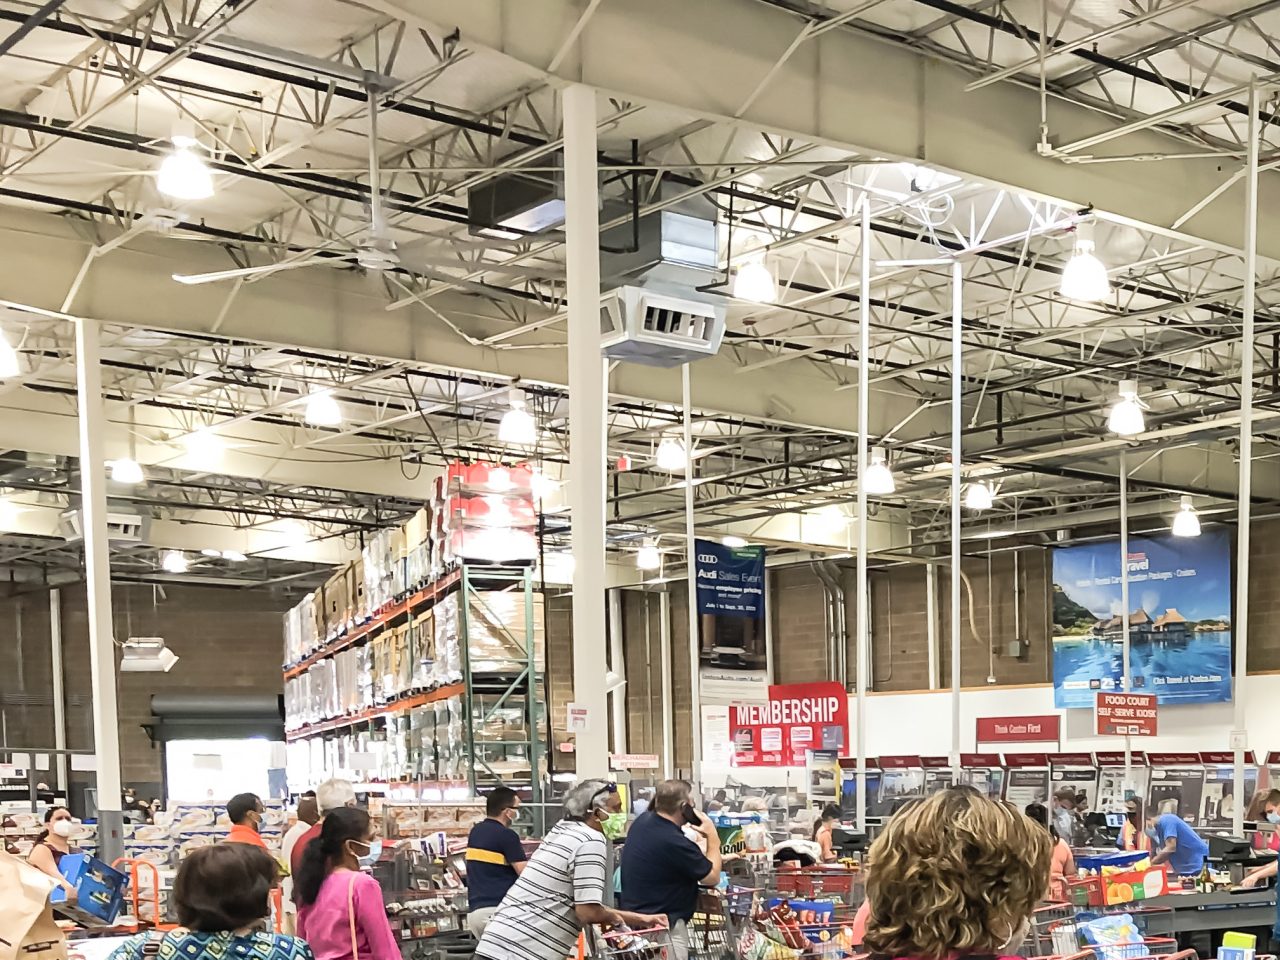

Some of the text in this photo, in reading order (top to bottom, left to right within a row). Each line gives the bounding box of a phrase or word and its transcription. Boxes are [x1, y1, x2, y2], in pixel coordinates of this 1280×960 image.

[1127, 559, 1149, 571] ravel
[698, 569, 717, 579] Audi
[718, 571, 739, 581] Sales
[1153, 677, 1165, 685] Click
[1105, 696, 1149, 706] FOOD COURT
[736, 697, 839, 726] MEMBERSHIP
[1098, 708, 1157, 718] SELF-SERVE KIOSK
[1027, 724, 1041, 733] First
